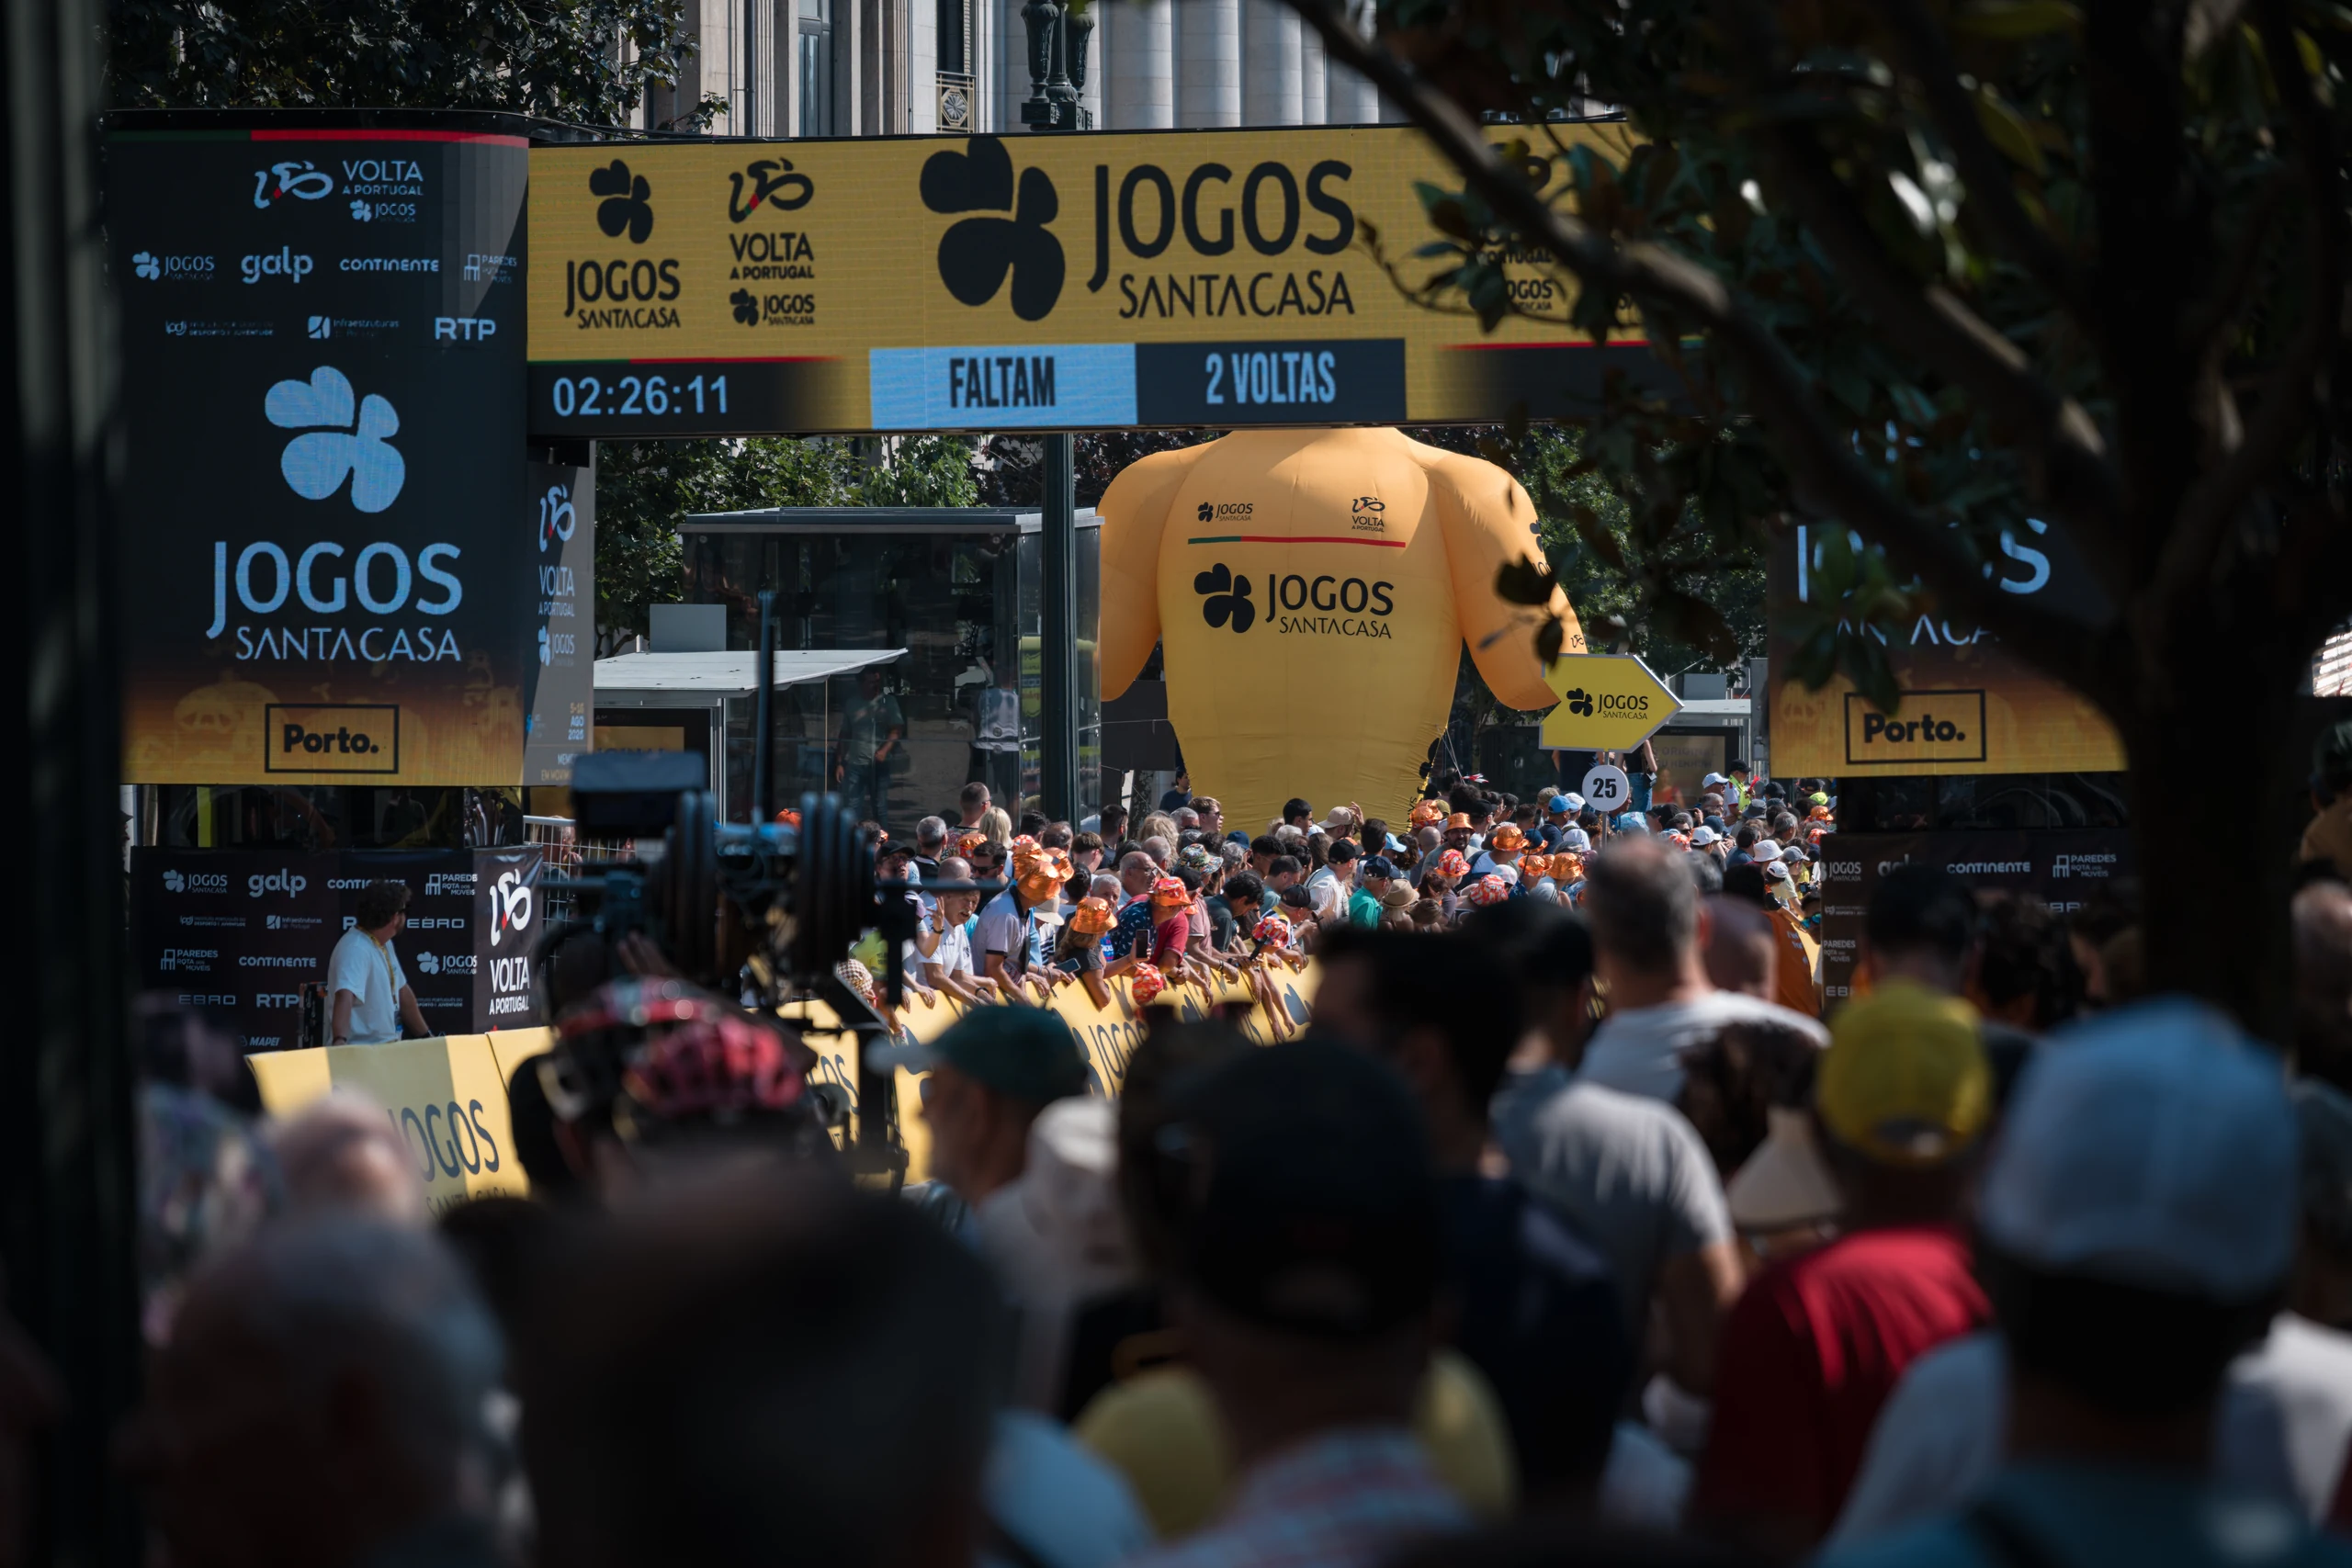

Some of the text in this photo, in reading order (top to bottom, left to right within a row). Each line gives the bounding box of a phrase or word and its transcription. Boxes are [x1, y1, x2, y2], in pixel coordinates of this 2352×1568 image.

[342, 160, 424, 182] VOLTA
[342, 185, 424, 196] A PORTUGAL
[374, 202, 416, 220] JOGOS
[1087, 160, 1355, 293] JOGOS
[729, 232, 814, 262] VOLTA
[164, 255, 215, 276] JOGOS
[240, 245, 314, 284] galp
[729, 265, 815, 279] A PORTUGAL
[565, 259, 681, 317] JOGOS
[1119, 270, 1355, 318] SANTACASA
[1505, 279, 1553, 299] OGOS
[579, 307, 681, 329] SANTACASA
[762, 294, 815, 320] JOGOS
[334, 319, 400, 329] Infraestruturas
[435, 317, 497, 342] RTP
[949, 356, 1056, 408] FALTAM
[1205, 351, 1337, 405] 2 VOLTAS
[552, 375, 729, 417] 02:26:11
[1216, 503, 1254, 518] JOGOS
[1351, 514, 1385, 527] VOLTA
[206, 541, 463, 640] JOGOS
[538, 564, 575, 597] VOLTA
[544, 602, 575, 617] PORTUGAL
[1265, 573, 1395, 624] JOGOS
[1280, 616, 1392, 639] SANTACASA
[235, 626, 463, 661] SANTACASA
[551, 634, 574, 660] JOGOS
[1598, 694, 1649, 714] JOGOS
[1863, 713, 1965, 743] Porto.
[284, 725, 379, 754] Porto.
[1592, 777, 1617, 798] 25
[2070, 853, 2118, 863] PAREDES
[1828, 861, 1862, 878] JOGOS
[187, 874, 228, 890] JOGOS
[247, 867, 307, 898] galp
[176, 949, 219, 958] PAREDES
[1823, 940, 1856, 949] PAREDES
[442, 955, 478, 972] JOGOS
[489, 955, 530, 994] VOLTA
[256, 994, 300, 1009] RTP
[489, 995, 530, 1016] A PORTUGAL
[249, 1036, 281, 1047] MAPEI
